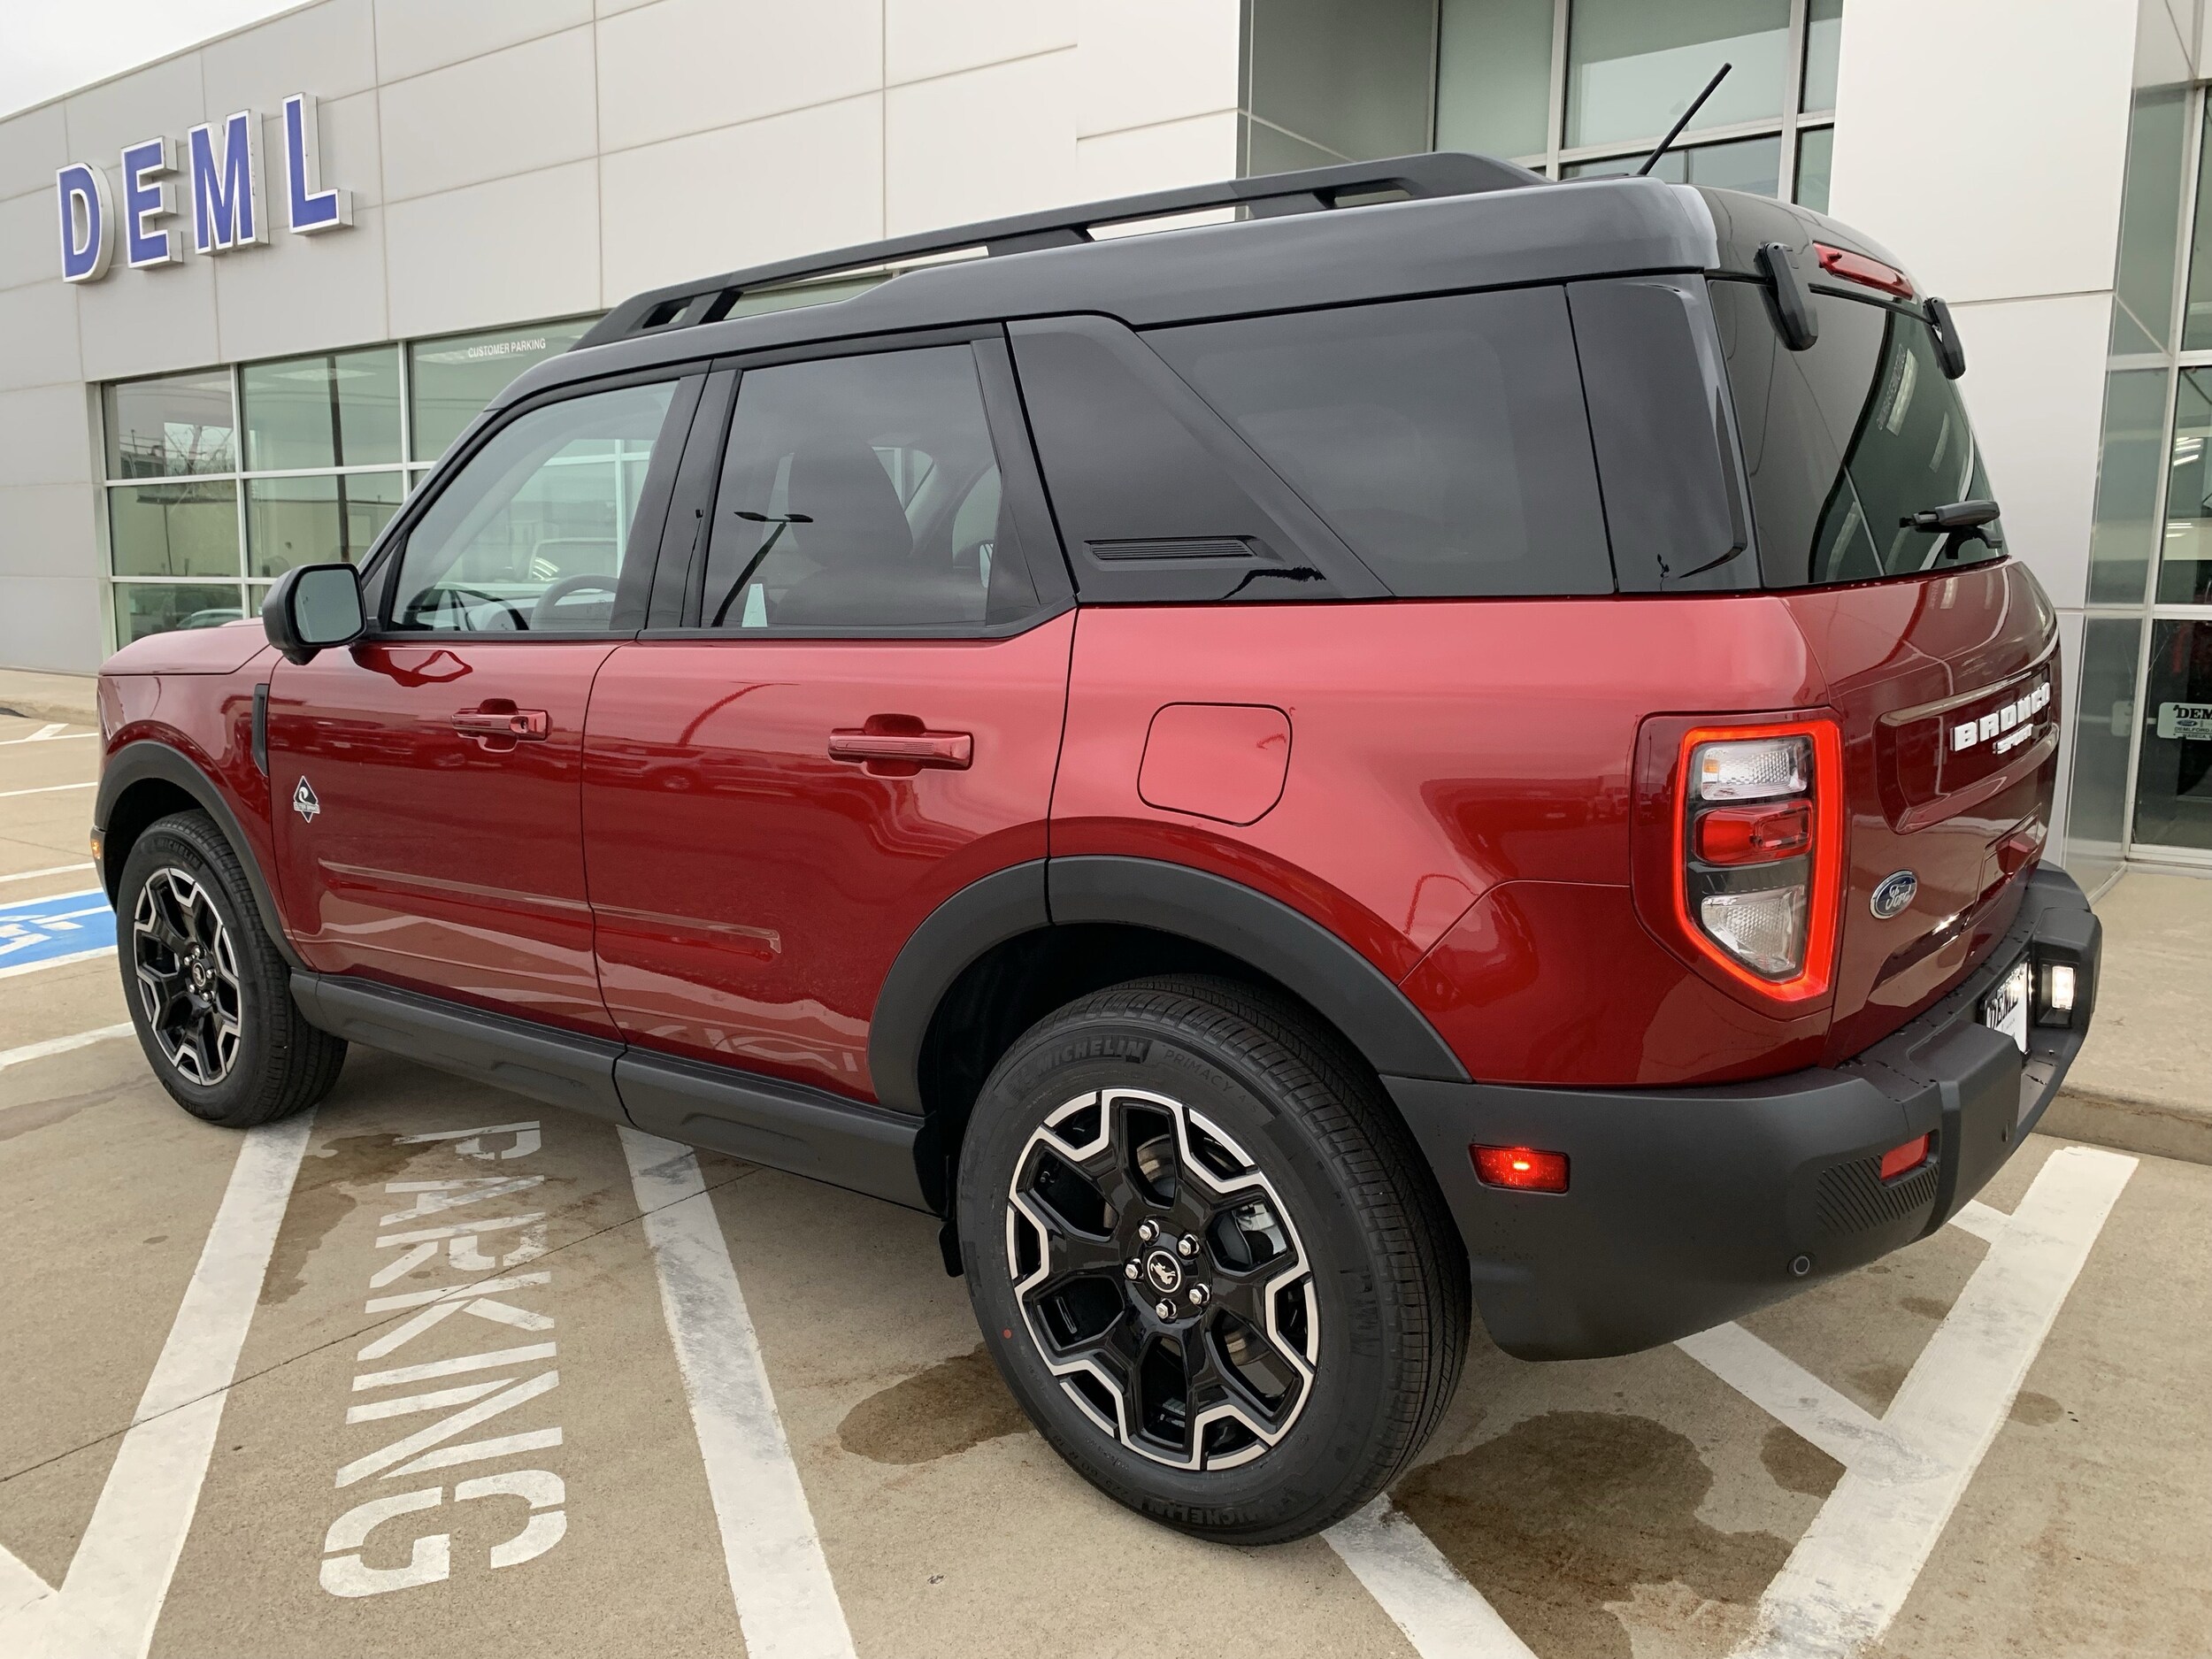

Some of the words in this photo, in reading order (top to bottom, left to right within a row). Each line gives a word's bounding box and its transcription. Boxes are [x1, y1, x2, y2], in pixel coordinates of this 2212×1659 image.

[56, 92, 352, 283] DEML
[468, 342, 510, 357] CUSTOMER
[511, 338, 546, 353] PARKING
[1037, 1038, 1144, 1075] MICHELIN
[1163, 1048, 1234, 1093] PRIMACY
[319, 1120, 567, 1598] PARKING
